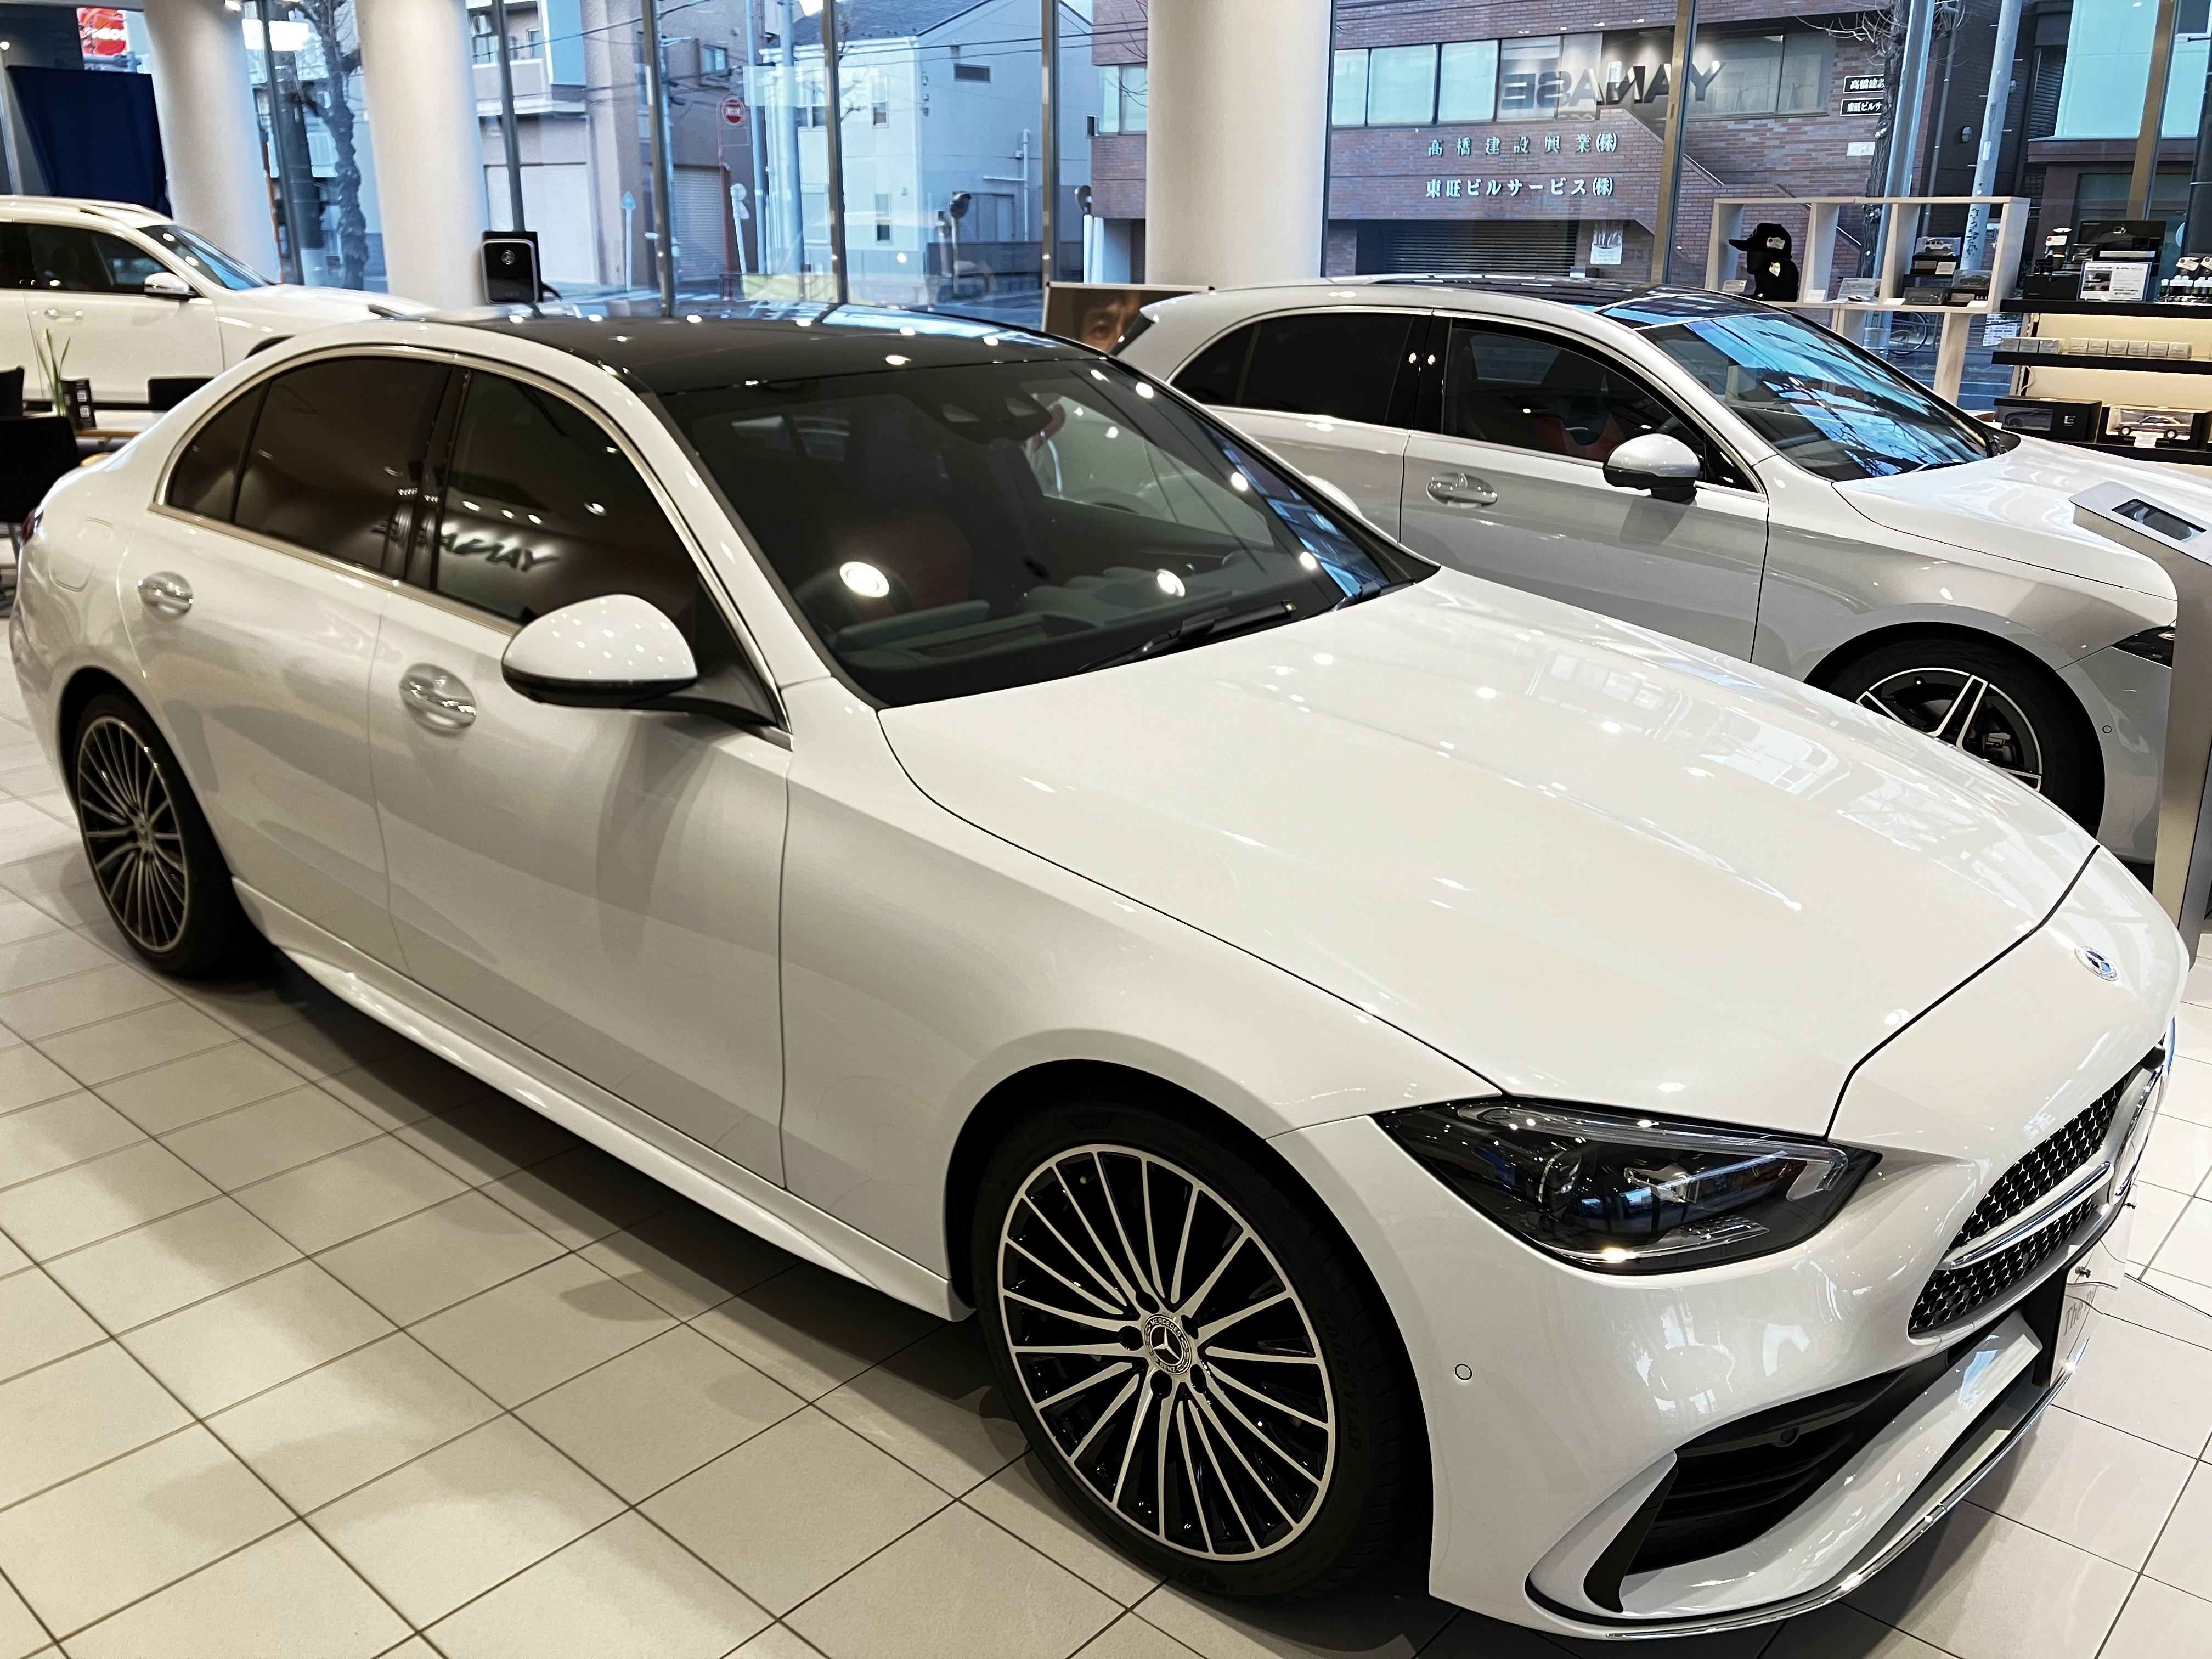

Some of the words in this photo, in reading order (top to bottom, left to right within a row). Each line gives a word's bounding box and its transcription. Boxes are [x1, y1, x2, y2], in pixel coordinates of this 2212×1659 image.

[1150, 1317, 1181, 1336] MERCEDES
[1160, 1361, 1177, 1373] BENZ
[1317, 1307, 1361, 1452] GOODYEAR
